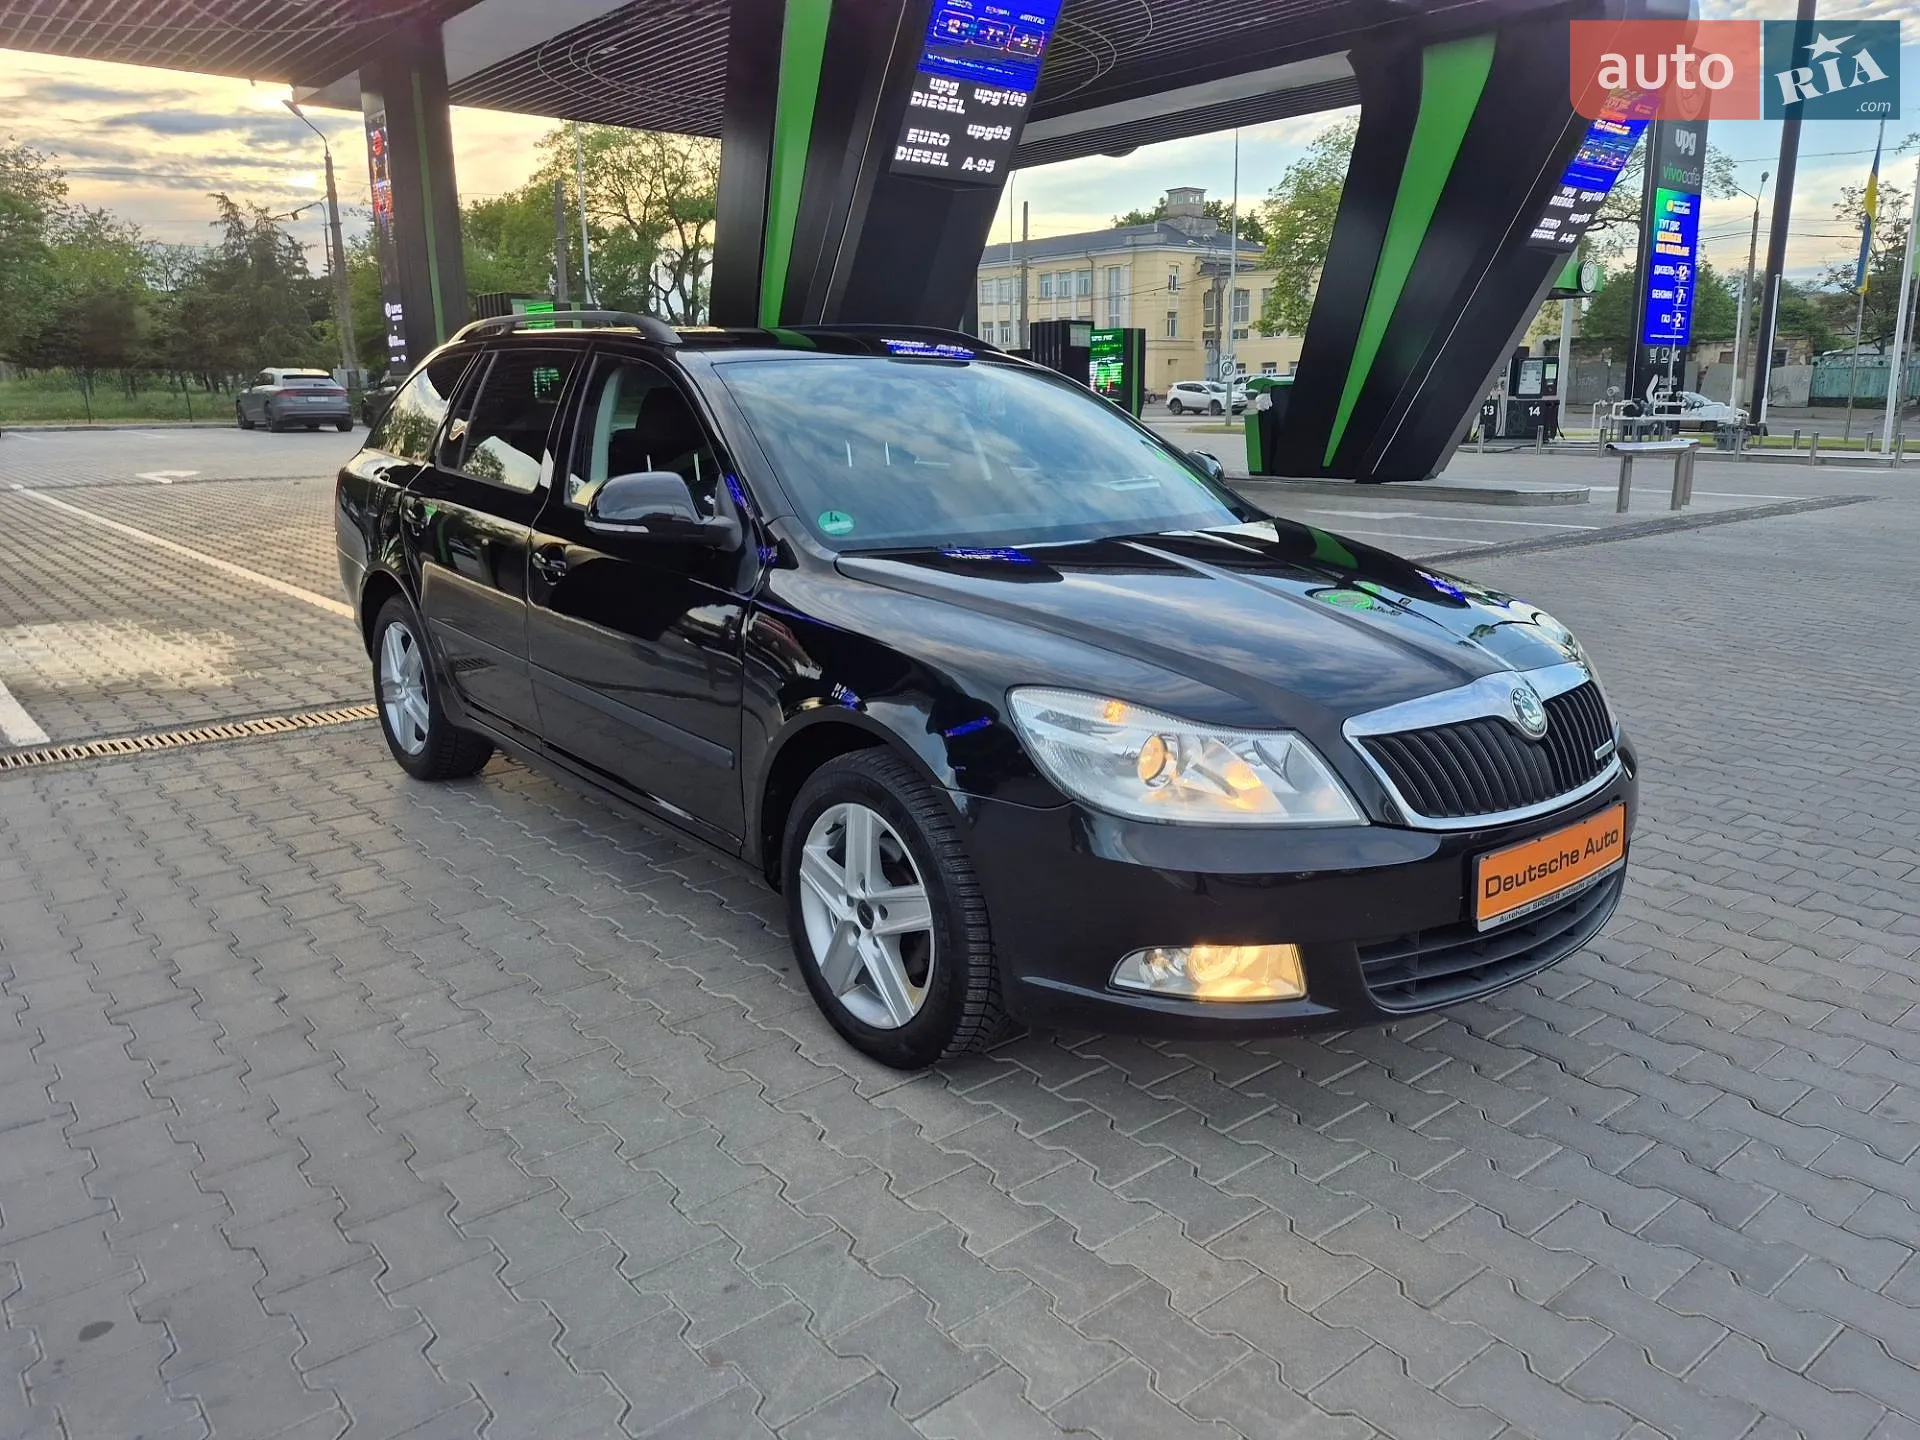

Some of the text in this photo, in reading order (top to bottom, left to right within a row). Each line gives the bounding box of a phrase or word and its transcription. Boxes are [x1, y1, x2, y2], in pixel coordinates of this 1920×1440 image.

[929, 77, 960, 97] upg
[910, 91, 966, 115] DIESEL
[973, 88, 1028, 107] upg100
[906, 128, 951, 147] EURO
[966, 124, 1013, 141] upg95
[1675, 129, 1697, 156] upg
[894, 146, 950, 167] DIESEL
[961, 156, 996, 173] A-95
[1549, 195, 1576, 208] DIESEL
[1482, 405, 1495, 416] 13
[1528, 406, 1541, 416] 14
[1485, 828, 1619, 899] Deutsche Auto
